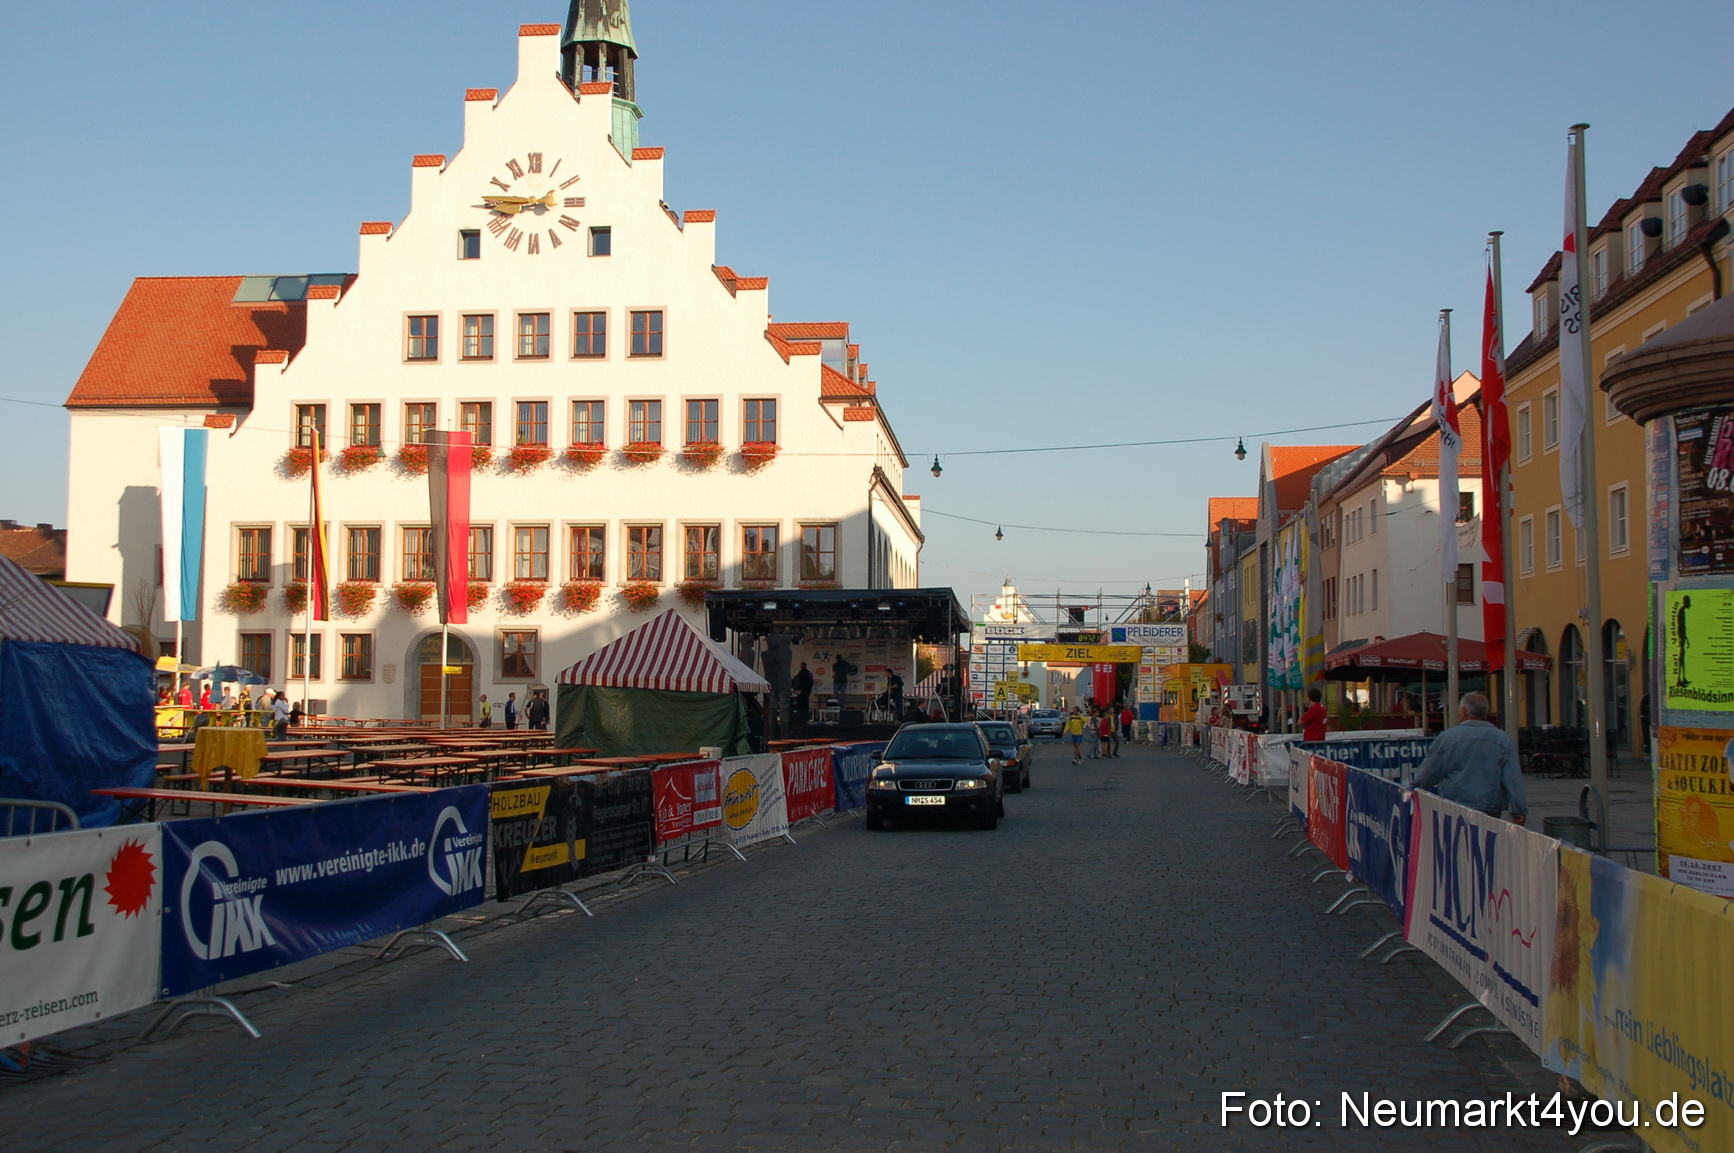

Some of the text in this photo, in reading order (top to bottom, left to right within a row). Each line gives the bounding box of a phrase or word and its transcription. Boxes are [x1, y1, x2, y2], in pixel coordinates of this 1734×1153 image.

[1127, 626, 1184, 637] PFLEIDERER
[1670, 600, 1680, 645] Valentin
[985, 626, 1025, 638] BOCK
[1065, 647, 1094, 659] ZIEL
[997, 686, 1006, 697] A
[1200, 683, 1208, 694] A
[1668, 685, 1734, 704] Riesenblödsinn
[493, 792, 541, 812] HOLZBAU
[451, 831, 483, 849] Vereinigte
[494, 815, 557, 849] KREUZER
[276, 837, 426, 887] www.vereinigte-ikk.de
[529, 850, 558, 865] Neumarkt
[1431, 810, 1497, 939] MCM
[222, 876, 268, 896] Vereinigte
